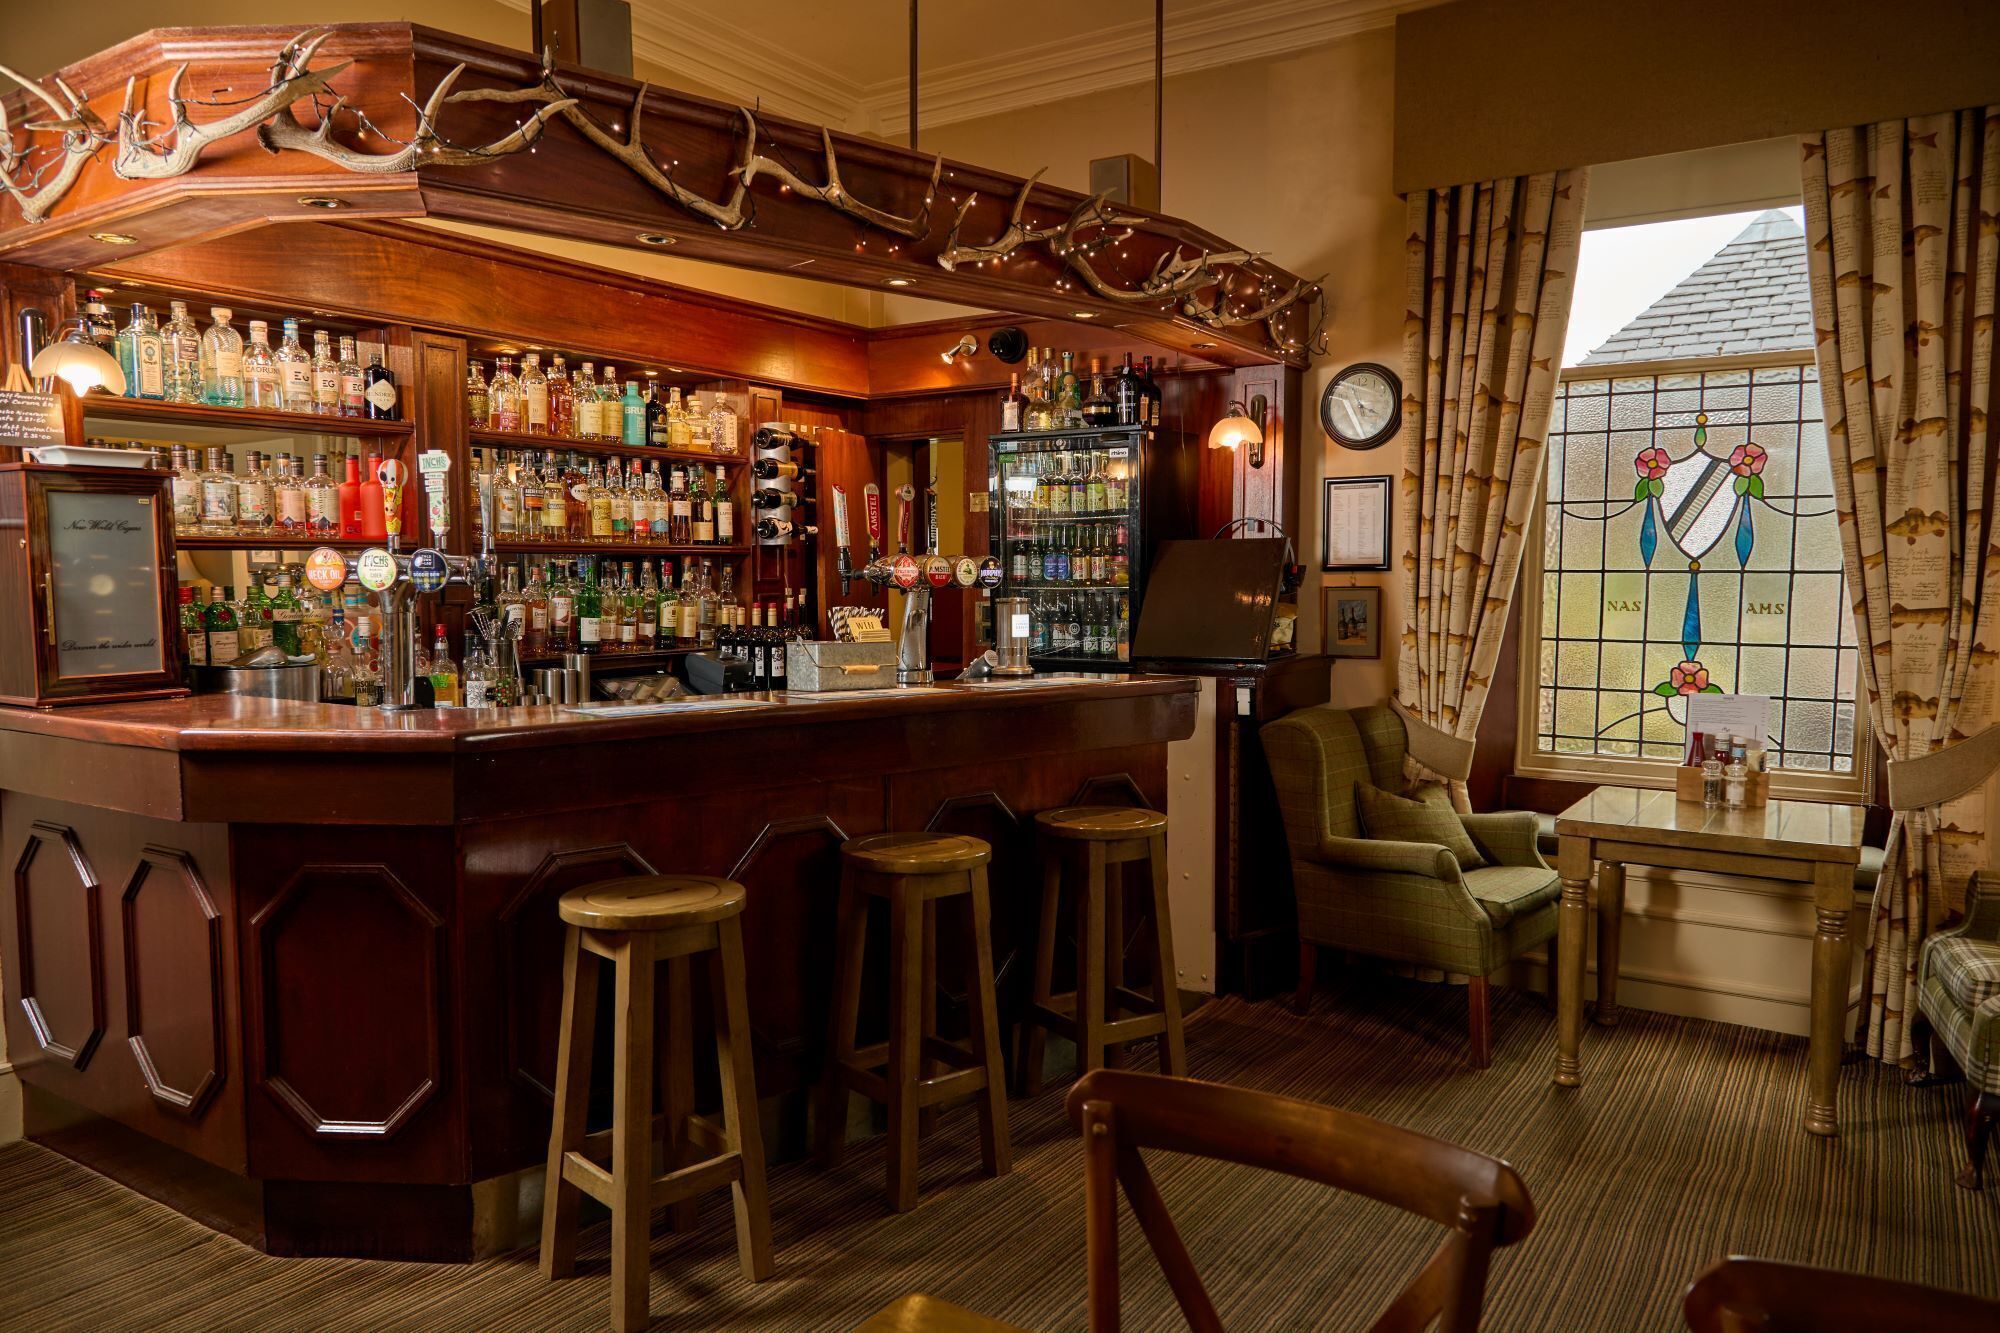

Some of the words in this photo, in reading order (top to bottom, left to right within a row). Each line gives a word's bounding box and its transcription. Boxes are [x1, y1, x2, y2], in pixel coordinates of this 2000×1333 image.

[869, 495, 878, 531] AMSTEL
[1607, 600, 1641, 611] NAS
[1745, 603, 1784, 615] AMS
[855, 620, 875, 632] WIN
